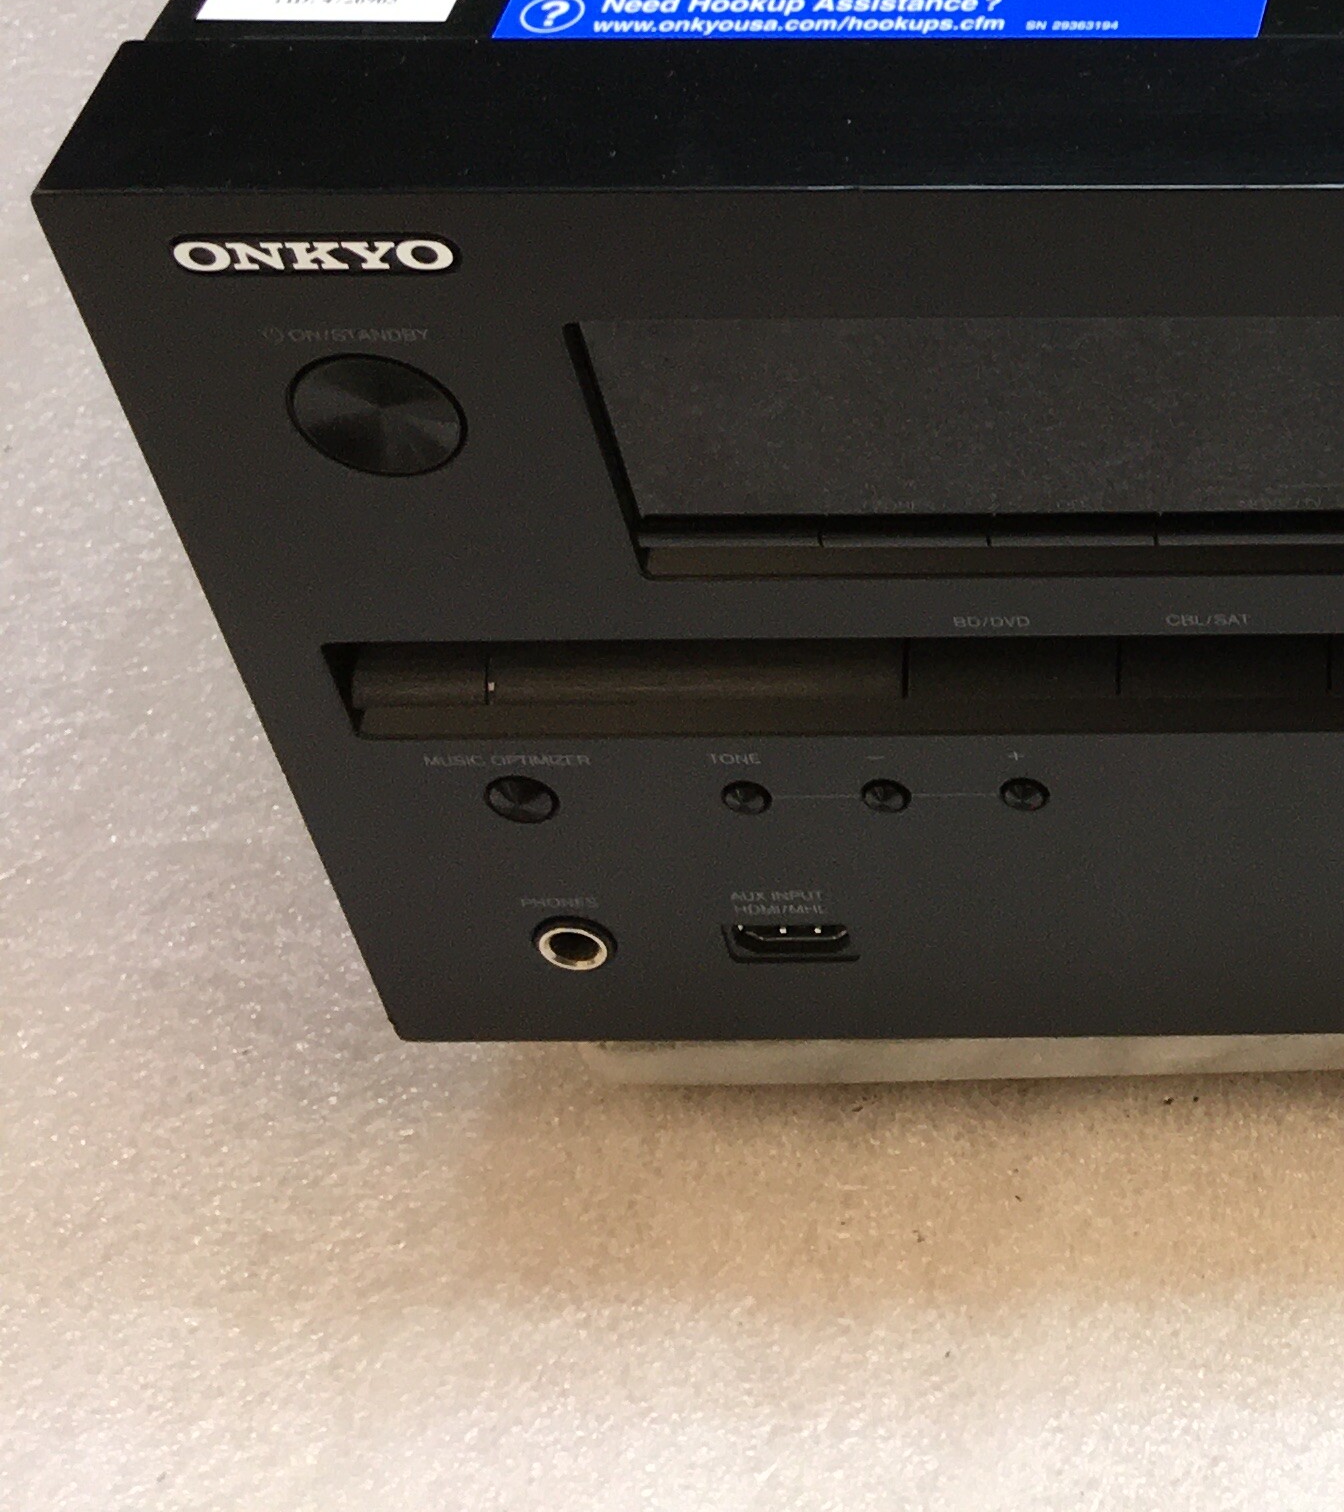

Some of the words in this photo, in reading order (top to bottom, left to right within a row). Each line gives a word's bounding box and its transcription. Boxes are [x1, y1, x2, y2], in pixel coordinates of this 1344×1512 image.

[592, 16, 1006, 36] www.onkyousa.com/hookups.cfm
[1025, 20, 1047, 31] SN
[173, 239, 454, 273] ONKYO
[952, 615, 1030, 629] BD/DVD
[1164, 613, 1250, 627] CBL/SAT
[423, 754, 487, 767] MUSIC
[490, 753, 592, 766] OPTIMIZER
[705, 752, 762, 765] TONE
[518, 896, 599, 909] PHONES
[730, 891, 768, 902] AUX
[770, 890, 823, 902] INPUT
